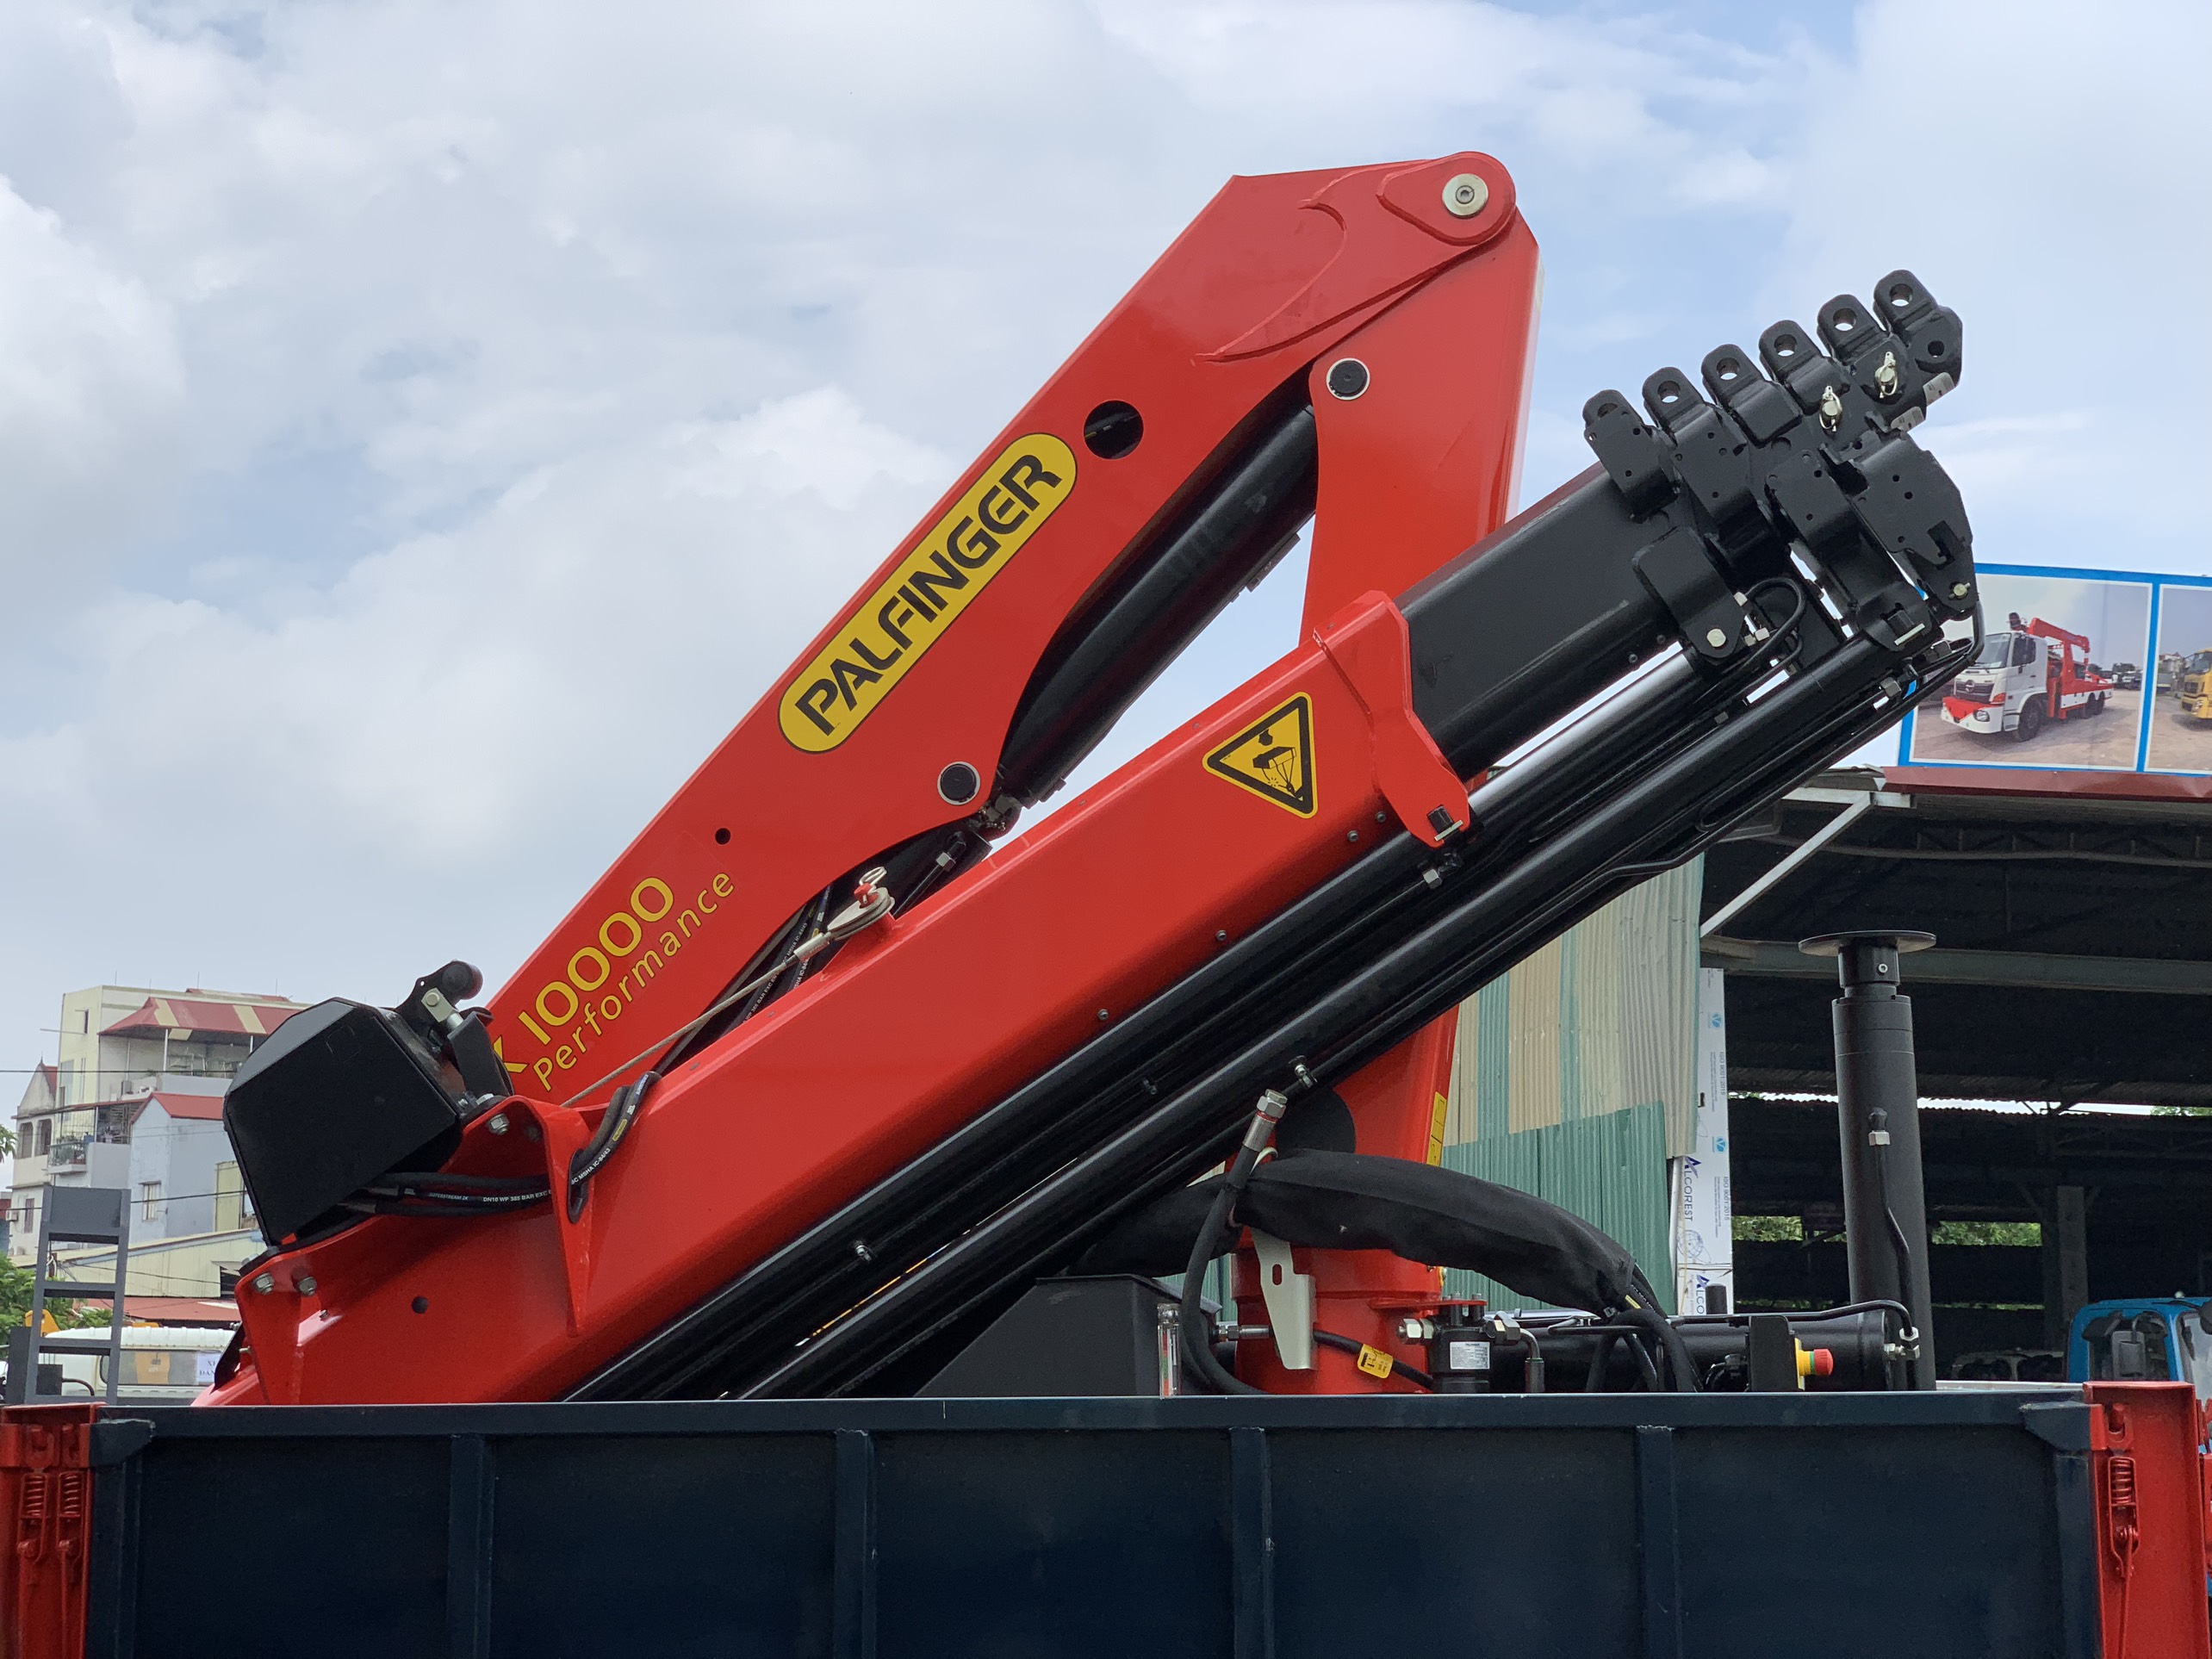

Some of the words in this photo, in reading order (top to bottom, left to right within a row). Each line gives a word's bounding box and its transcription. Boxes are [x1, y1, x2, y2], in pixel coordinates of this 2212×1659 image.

[794, 454, 1064, 736] PALFINGER
[518, 877, 675, 1047] 10000
[533, 873, 735, 1092] Performance
[1684, 1155, 1702, 1221] ALCOREST
